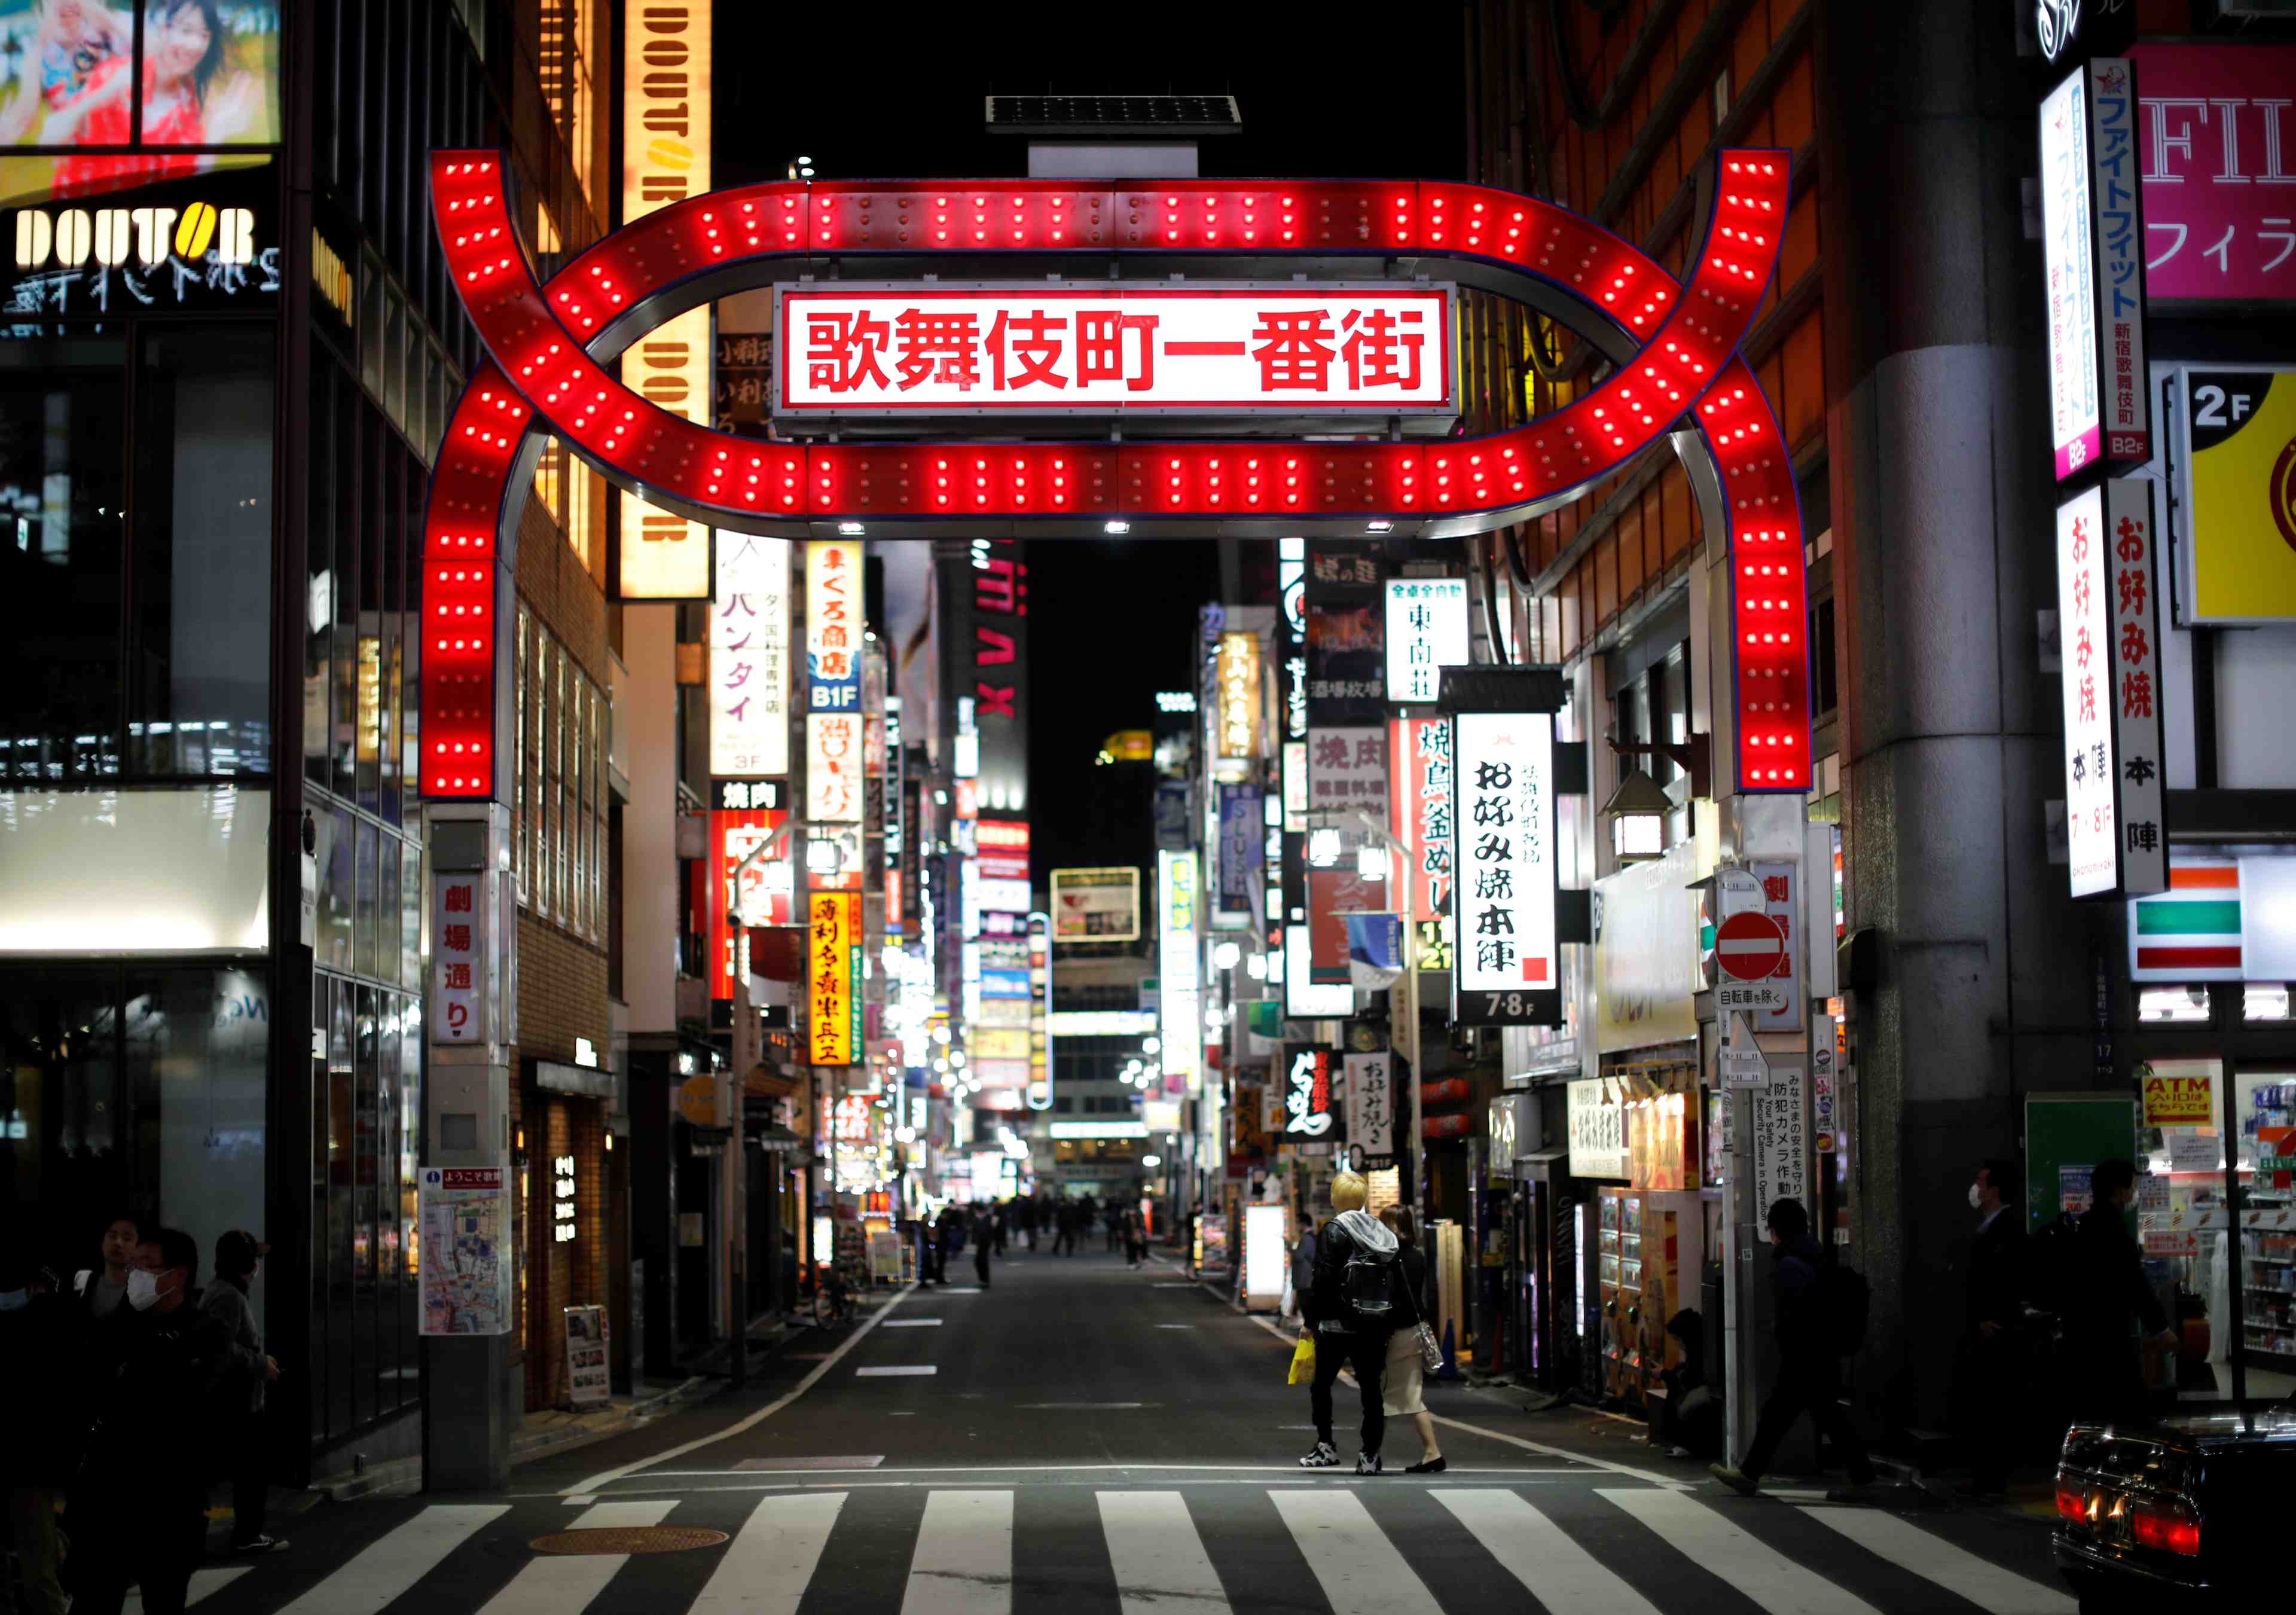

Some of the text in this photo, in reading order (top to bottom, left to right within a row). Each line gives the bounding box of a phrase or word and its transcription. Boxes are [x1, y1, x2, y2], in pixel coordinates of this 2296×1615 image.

[643, 7, 694, 202] DOUTOR
[16, 202, 254, 265] DOUTOR
[2095, 97, 2136, 317] ファイトフィット
[2147, 218, 2296, 272] フィラ
[806, 307, 1424, 393] 歌舞伎町一番街
[2114, 322, 2134, 425] 新宿歌舞伎町
[2194, 384, 2250, 427] 2F
[2069, 438, 2086, 469] B2F
[2112, 436, 2144, 455] B2F
[2071, 515, 2096, 725] お好み焼
[1408, 603, 1431, 698] 東南荘
[812, 686, 857, 707] B1F
[2116, 515, 2158, 853] お好み焼 本陣
[734, 755, 761, 769] 3F
[2072, 738, 2106, 791] 本陣
[723, 781, 777, 809] 焼肉
[1421, 723, 1451, 915] 焼鳥釜めし
[1234, 802, 1246, 895] SLUSH
[1474, 761, 1515, 973] お好み焼本陣
[444, 884, 472, 1028] 劇場通り
[1721, 990, 1780, 1005] 自転車を除く
[2097, 1044, 2112, 1057] 17
[2145, 1077, 2210, 1092] ATM
[1765, 1122, 1774, 1148] Safety
[1774, 1083, 1790, 1196] 防犯カメラ作動
[1758, 1180, 1768, 1220] Operation
